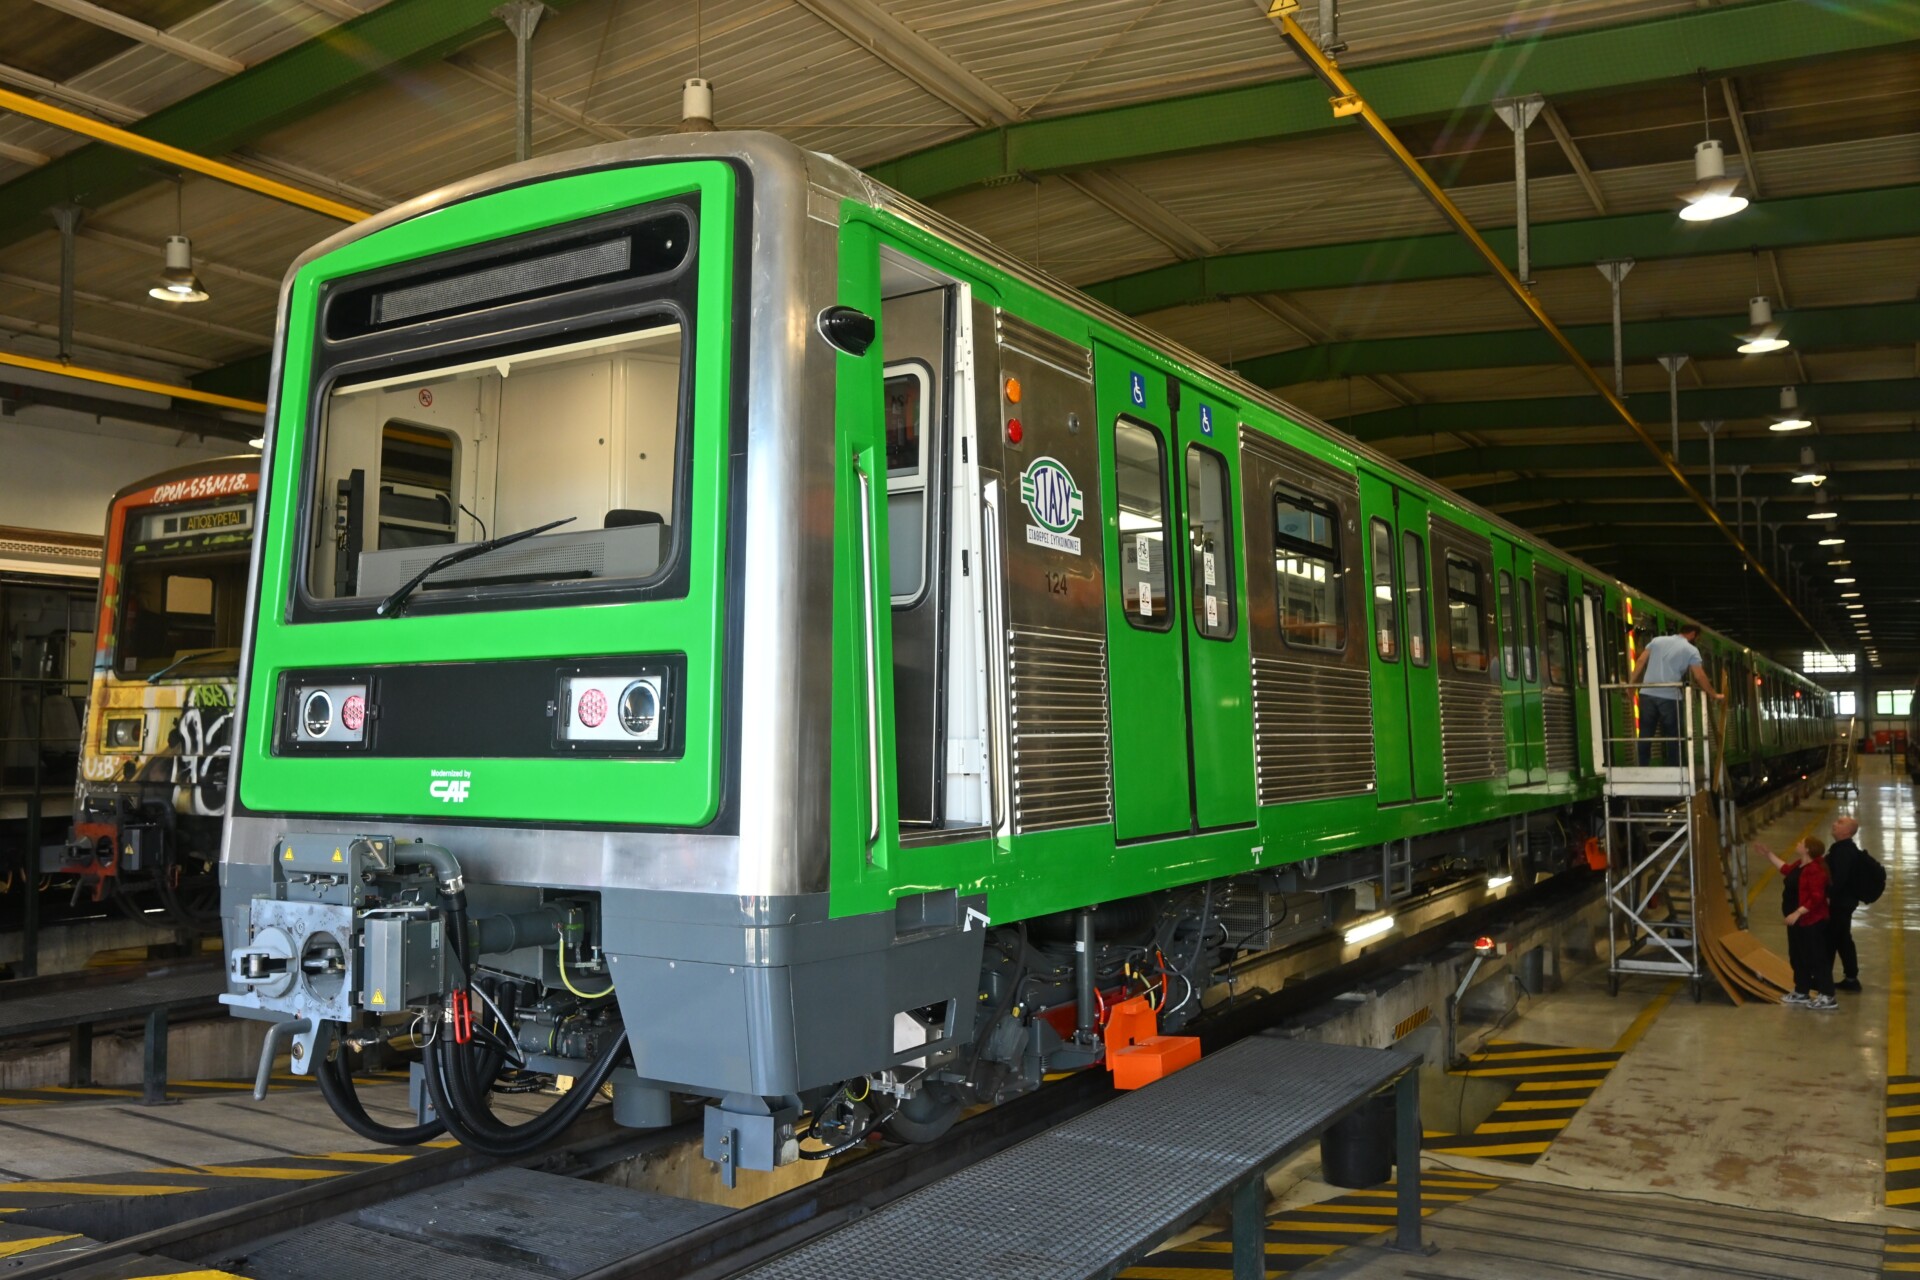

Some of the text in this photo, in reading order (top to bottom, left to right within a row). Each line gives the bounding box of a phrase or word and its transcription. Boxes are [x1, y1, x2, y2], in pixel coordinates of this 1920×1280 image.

[1034, 467, 1071, 526] ΣΤΑΣΥ
[187, 511, 240, 530] ΑΠΟΣΥΡΕΤΑΙ
[1028, 528, 1050, 544] ΣΤΑΘΕΡΕΣ
[1045, 571, 1068, 595] 124
[464, 770, 471, 779] by
[430, 780, 471, 802] CAF
